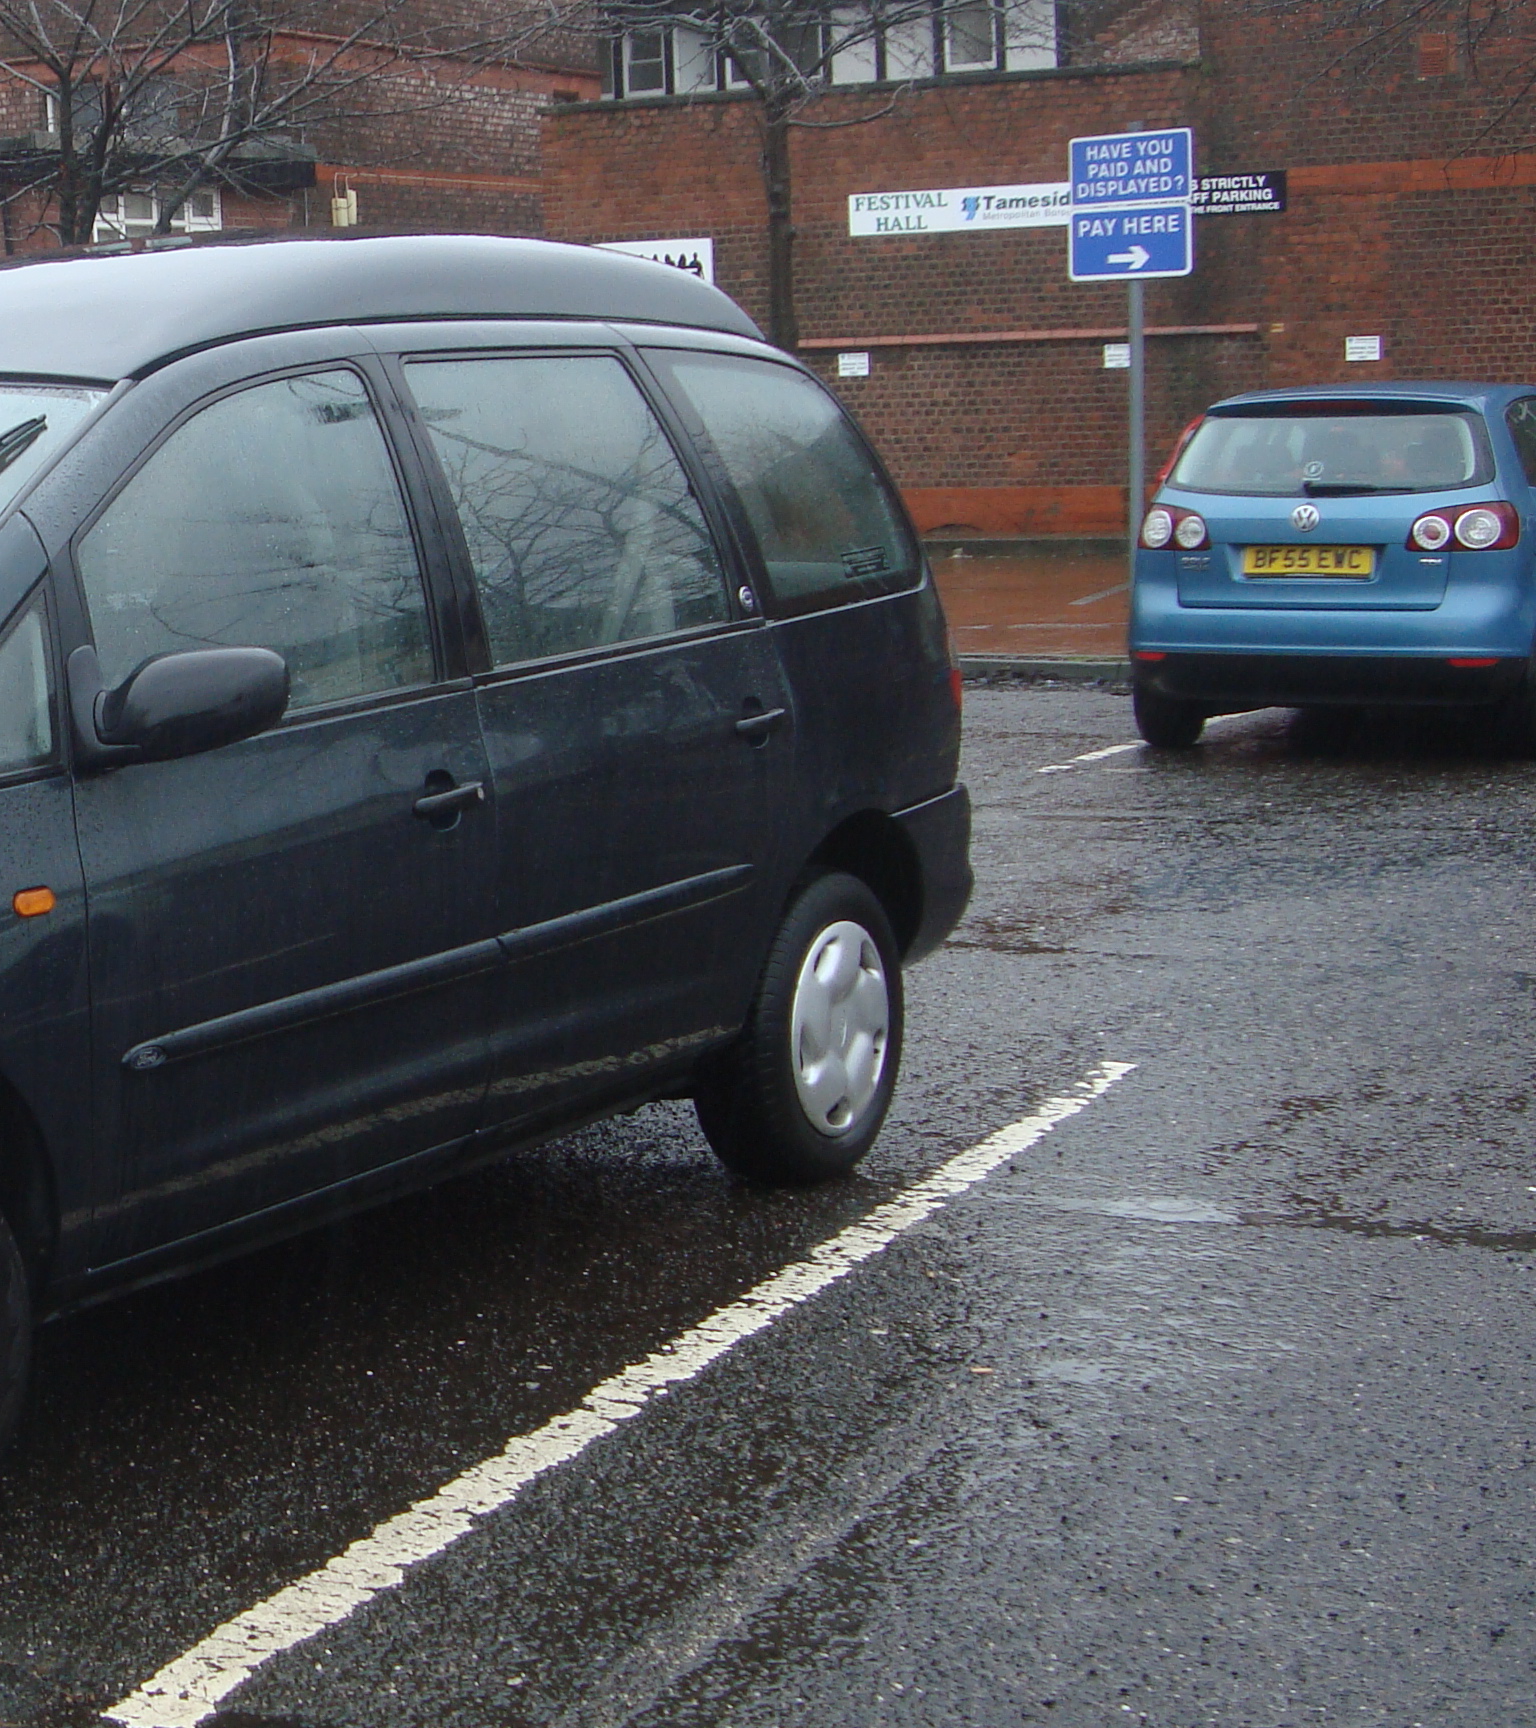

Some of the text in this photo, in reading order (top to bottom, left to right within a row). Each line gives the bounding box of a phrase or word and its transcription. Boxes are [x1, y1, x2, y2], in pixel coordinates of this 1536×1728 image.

[1086, 138, 1174, 160] HAVE YOU
[1087, 157, 1173, 178] PAID AND
[1076, 175, 1185, 198] DISPLAYED?
[1190, 175, 1266, 191] S STRICTLY
[855, 192, 948, 212] FESTIVAL
[982, 190, 1071, 211] Tamesid
[1190, 188, 1273, 204] FF PARKING
[982, 210, 1041, 220] Metropolitan
[1234, 201, 1280, 212] ENTRANCE
[876, 215, 928, 232] HALL
[1077, 214, 1181, 238] PAY HERE
[1253, 549, 1362, 569] BF55 EWC
